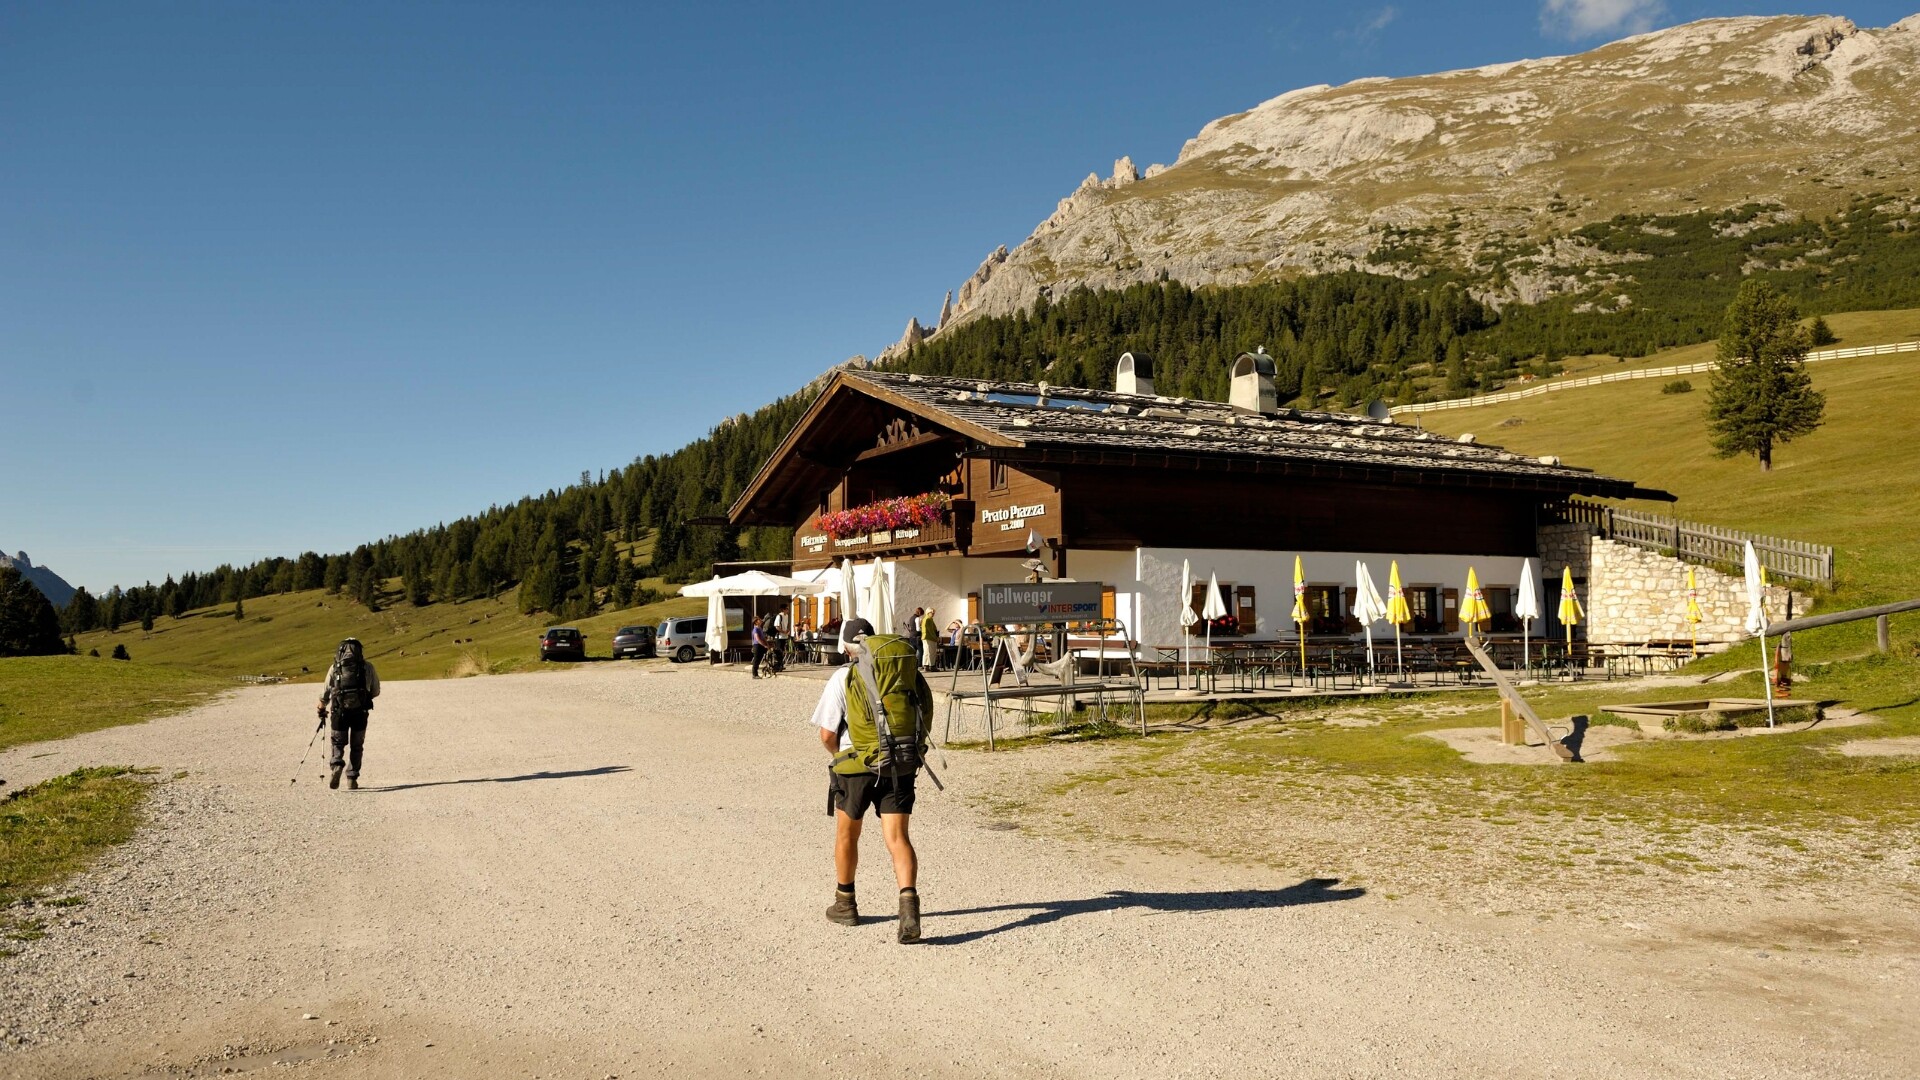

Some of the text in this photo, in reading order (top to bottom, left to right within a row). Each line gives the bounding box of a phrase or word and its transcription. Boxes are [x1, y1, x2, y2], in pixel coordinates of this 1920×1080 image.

[982, 504, 1045, 523] Prato Piazza
[895, 529, 919, 539] Rifugio
[987, 587, 1053, 606] hellweger
[1048, 603, 1098, 613] INTERSPORT
